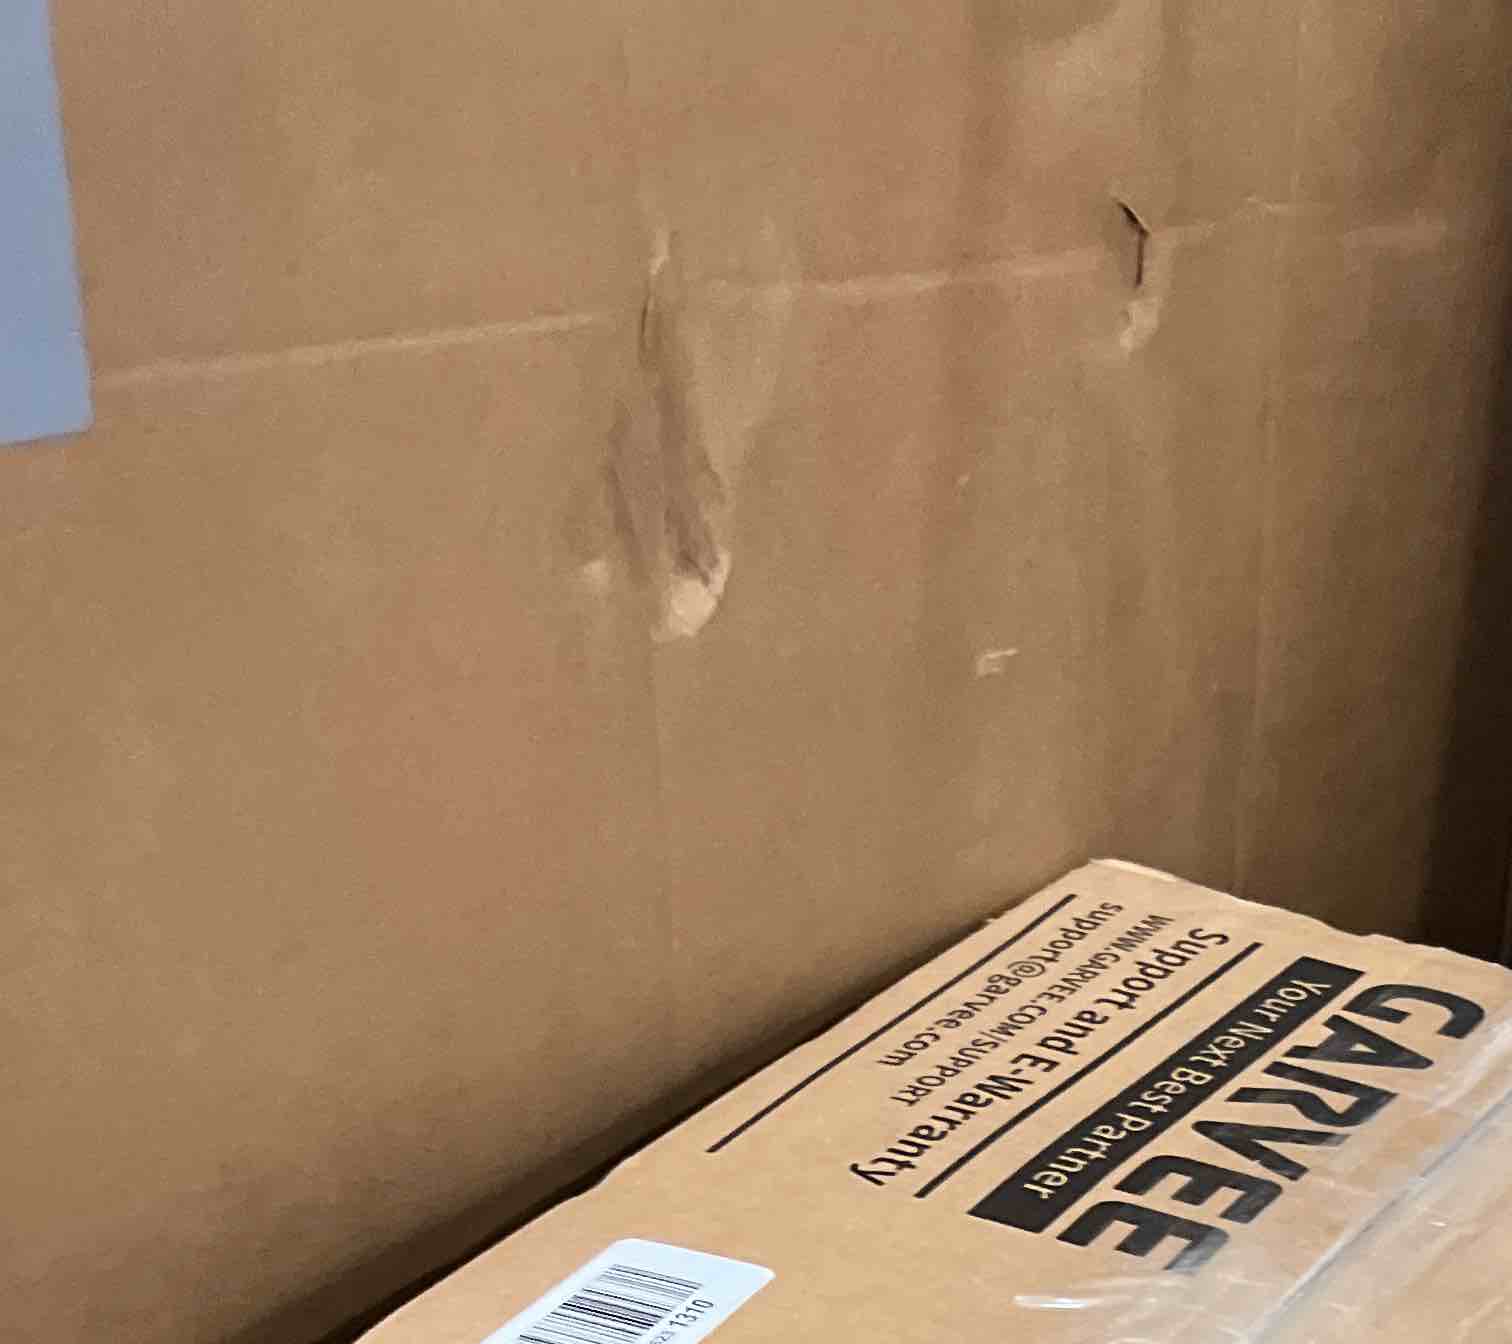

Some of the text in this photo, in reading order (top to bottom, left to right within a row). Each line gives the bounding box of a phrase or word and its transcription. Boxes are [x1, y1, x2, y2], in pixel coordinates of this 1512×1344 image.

[850, 927, 1230, 1186] Support and E-Warranty
[875, 901, 1123, 1067] support@garvee.com
[1024, 979, 1332, 1199] Your Next Best Partner
[1056, 982, 1487, 1272] GARVEE
[669, 1299, 714, 1326] 1310
